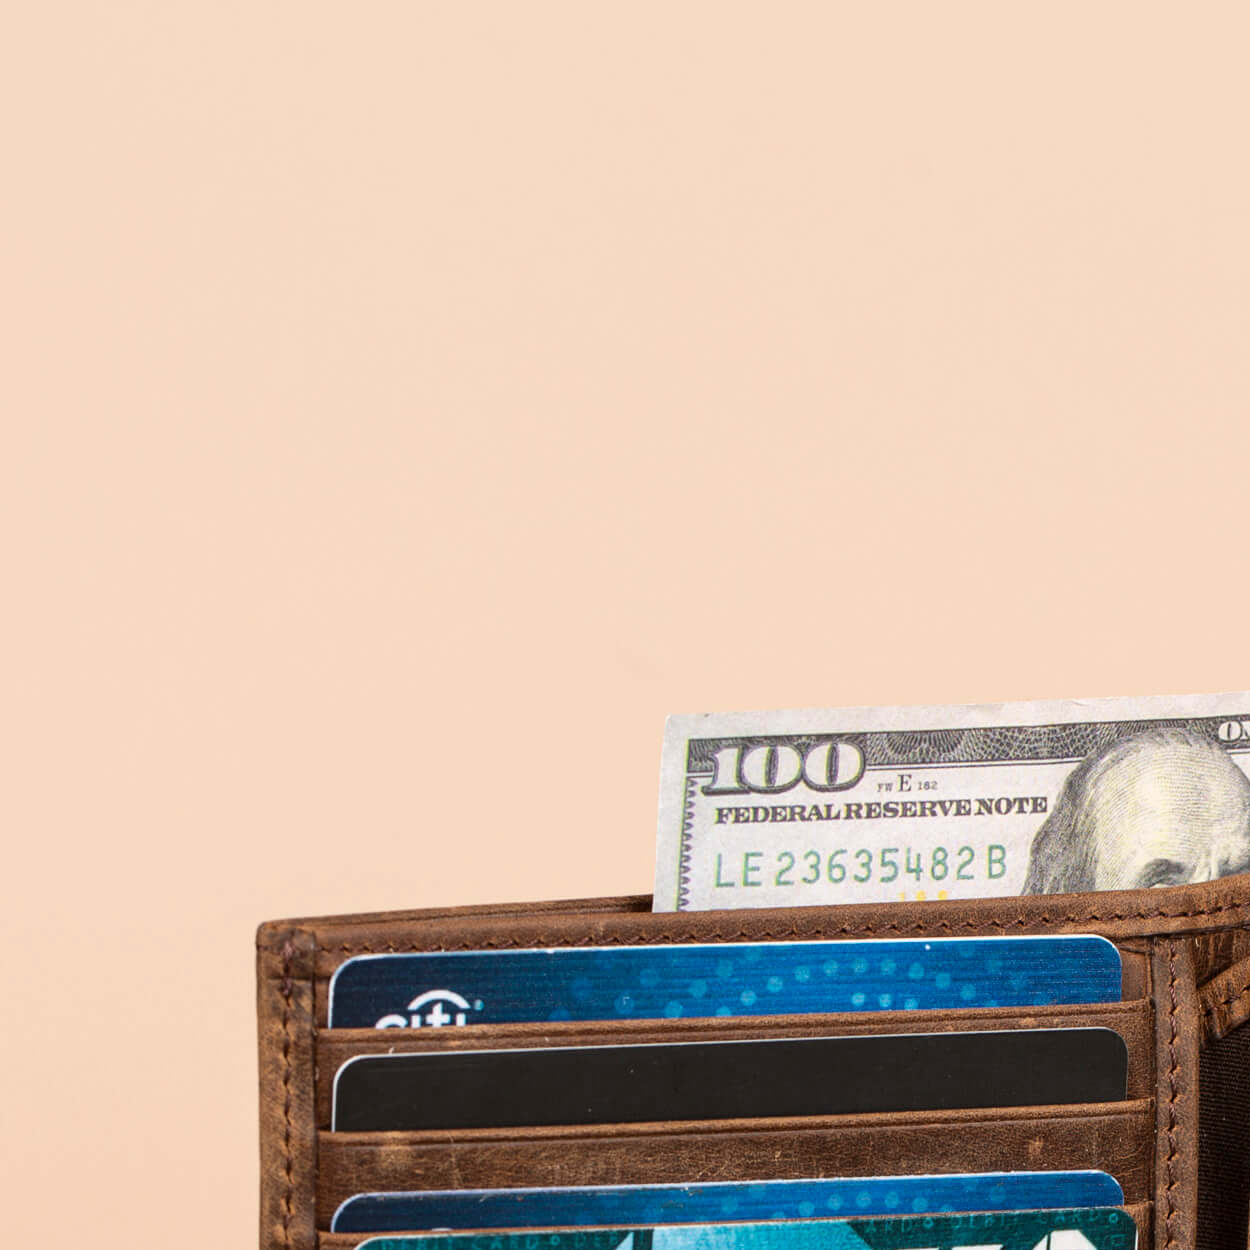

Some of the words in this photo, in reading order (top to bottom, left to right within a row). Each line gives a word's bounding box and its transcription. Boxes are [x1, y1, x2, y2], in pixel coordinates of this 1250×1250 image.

[701, 742, 867, 797] 100
[896, 774, 912, 793] E
[715, 804, 841, 824] FEDERAL
[843, 799, 973, 821] RESERVE
[974, 796, 1048, 816] NOTE
